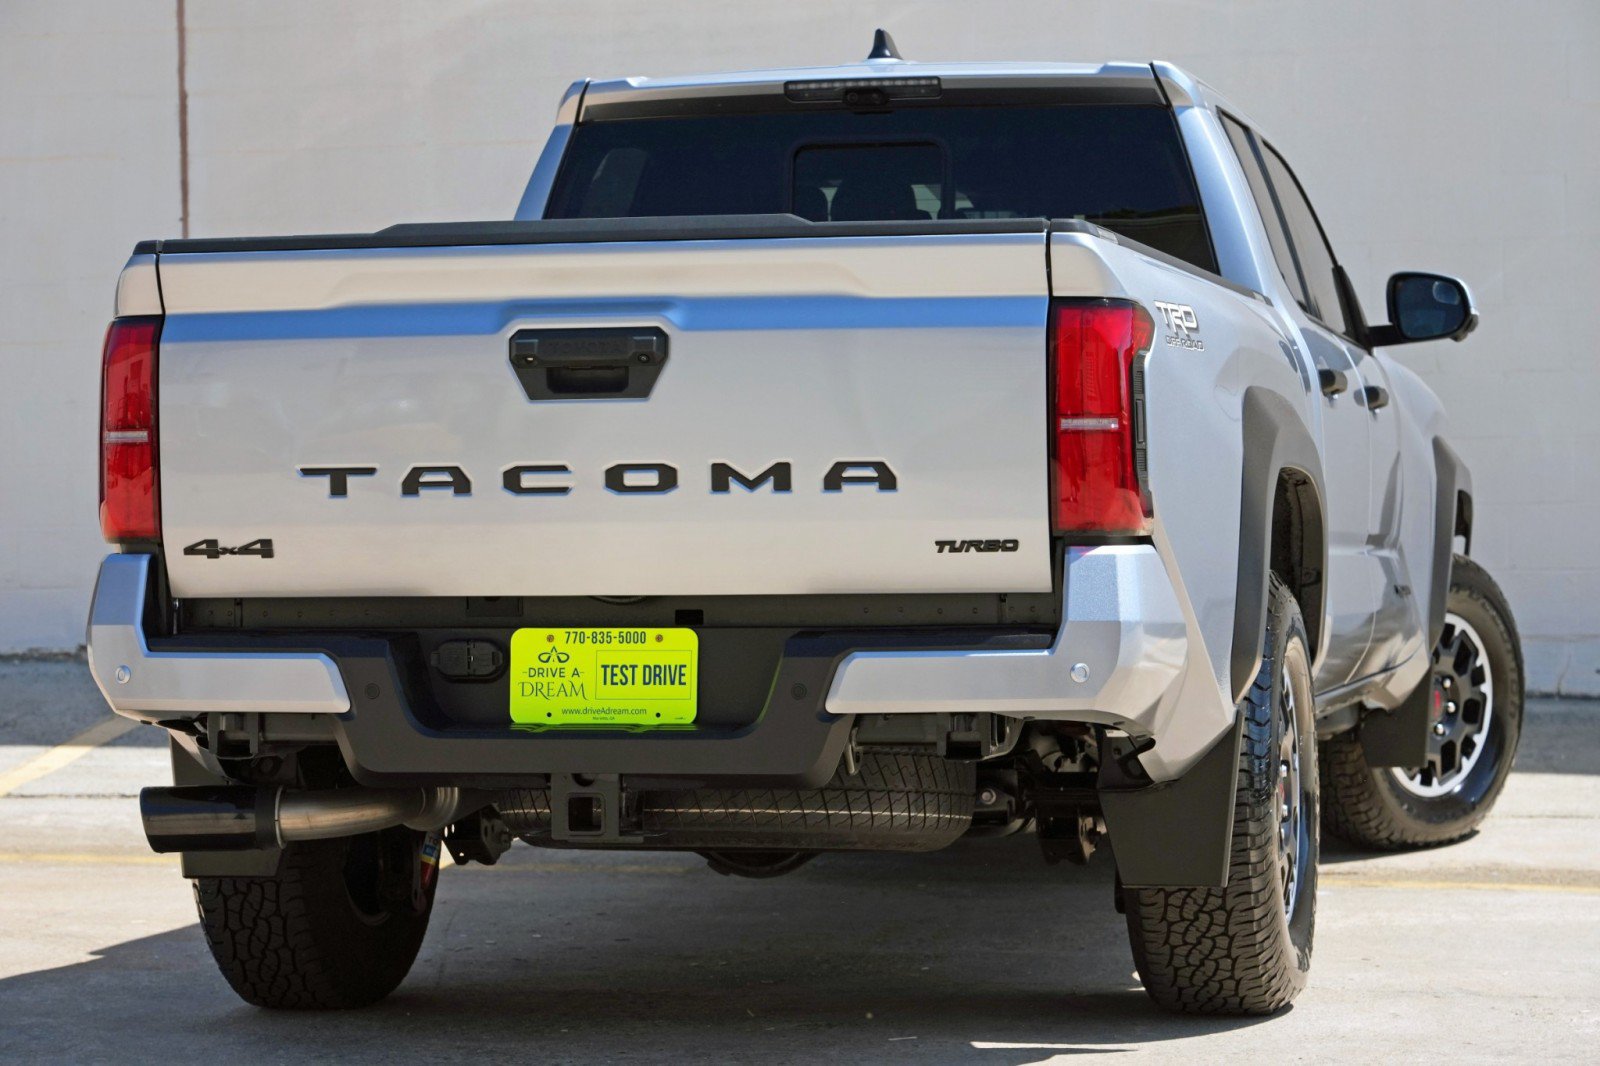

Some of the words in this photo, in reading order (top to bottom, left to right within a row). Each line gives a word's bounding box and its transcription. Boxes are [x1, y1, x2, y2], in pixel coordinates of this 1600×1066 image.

[1153, 300, 1198, 335] TRD
[298, 461, 898, 497] TACOMA
[934, 539, 1019, 553] TURBO
[565, 631, 646, 644] 770-835-5000
[528, 667, 566, 678] DRIVE
[571, 667, 581, 678] A
[600, 664, 638, 686] TEST
[642, 664, 687, 686] DRIVE
[518, 680, 590, 701] DREAM
[561, 706, 647, 715] www.driveAdream.com
